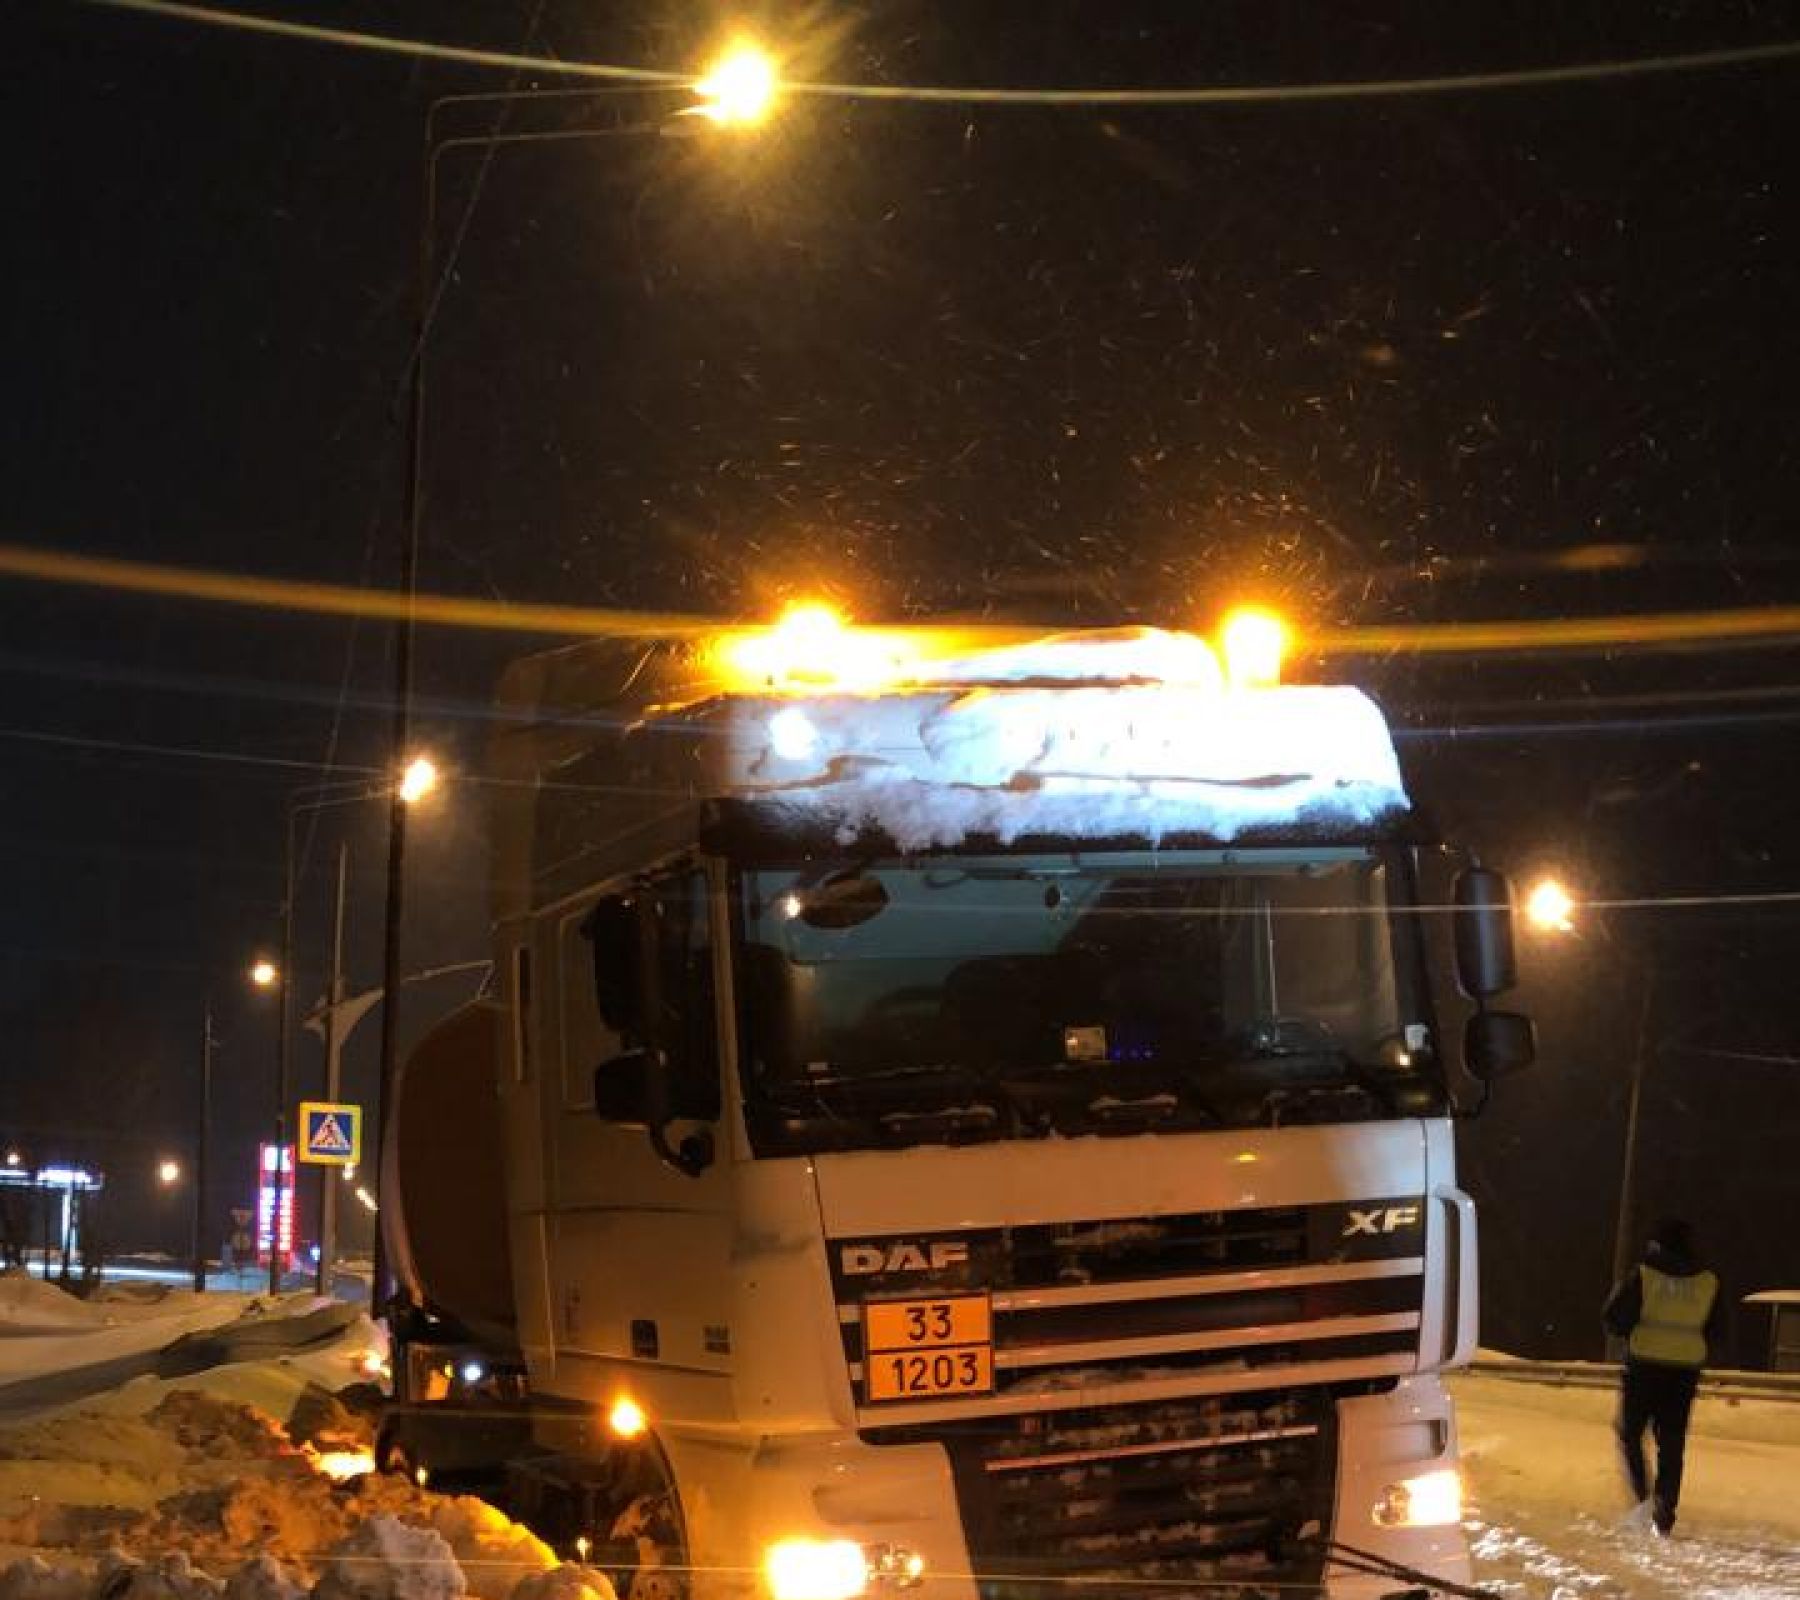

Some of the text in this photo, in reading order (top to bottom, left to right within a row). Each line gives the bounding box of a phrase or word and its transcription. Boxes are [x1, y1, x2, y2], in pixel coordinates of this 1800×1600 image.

[1344, 1207, 1420, 1235] XF
[842, 1243, 967, 1275] DAF
[906, 1303, 952, 1341] 33
[891, 1354, 978, 1393] 1203
